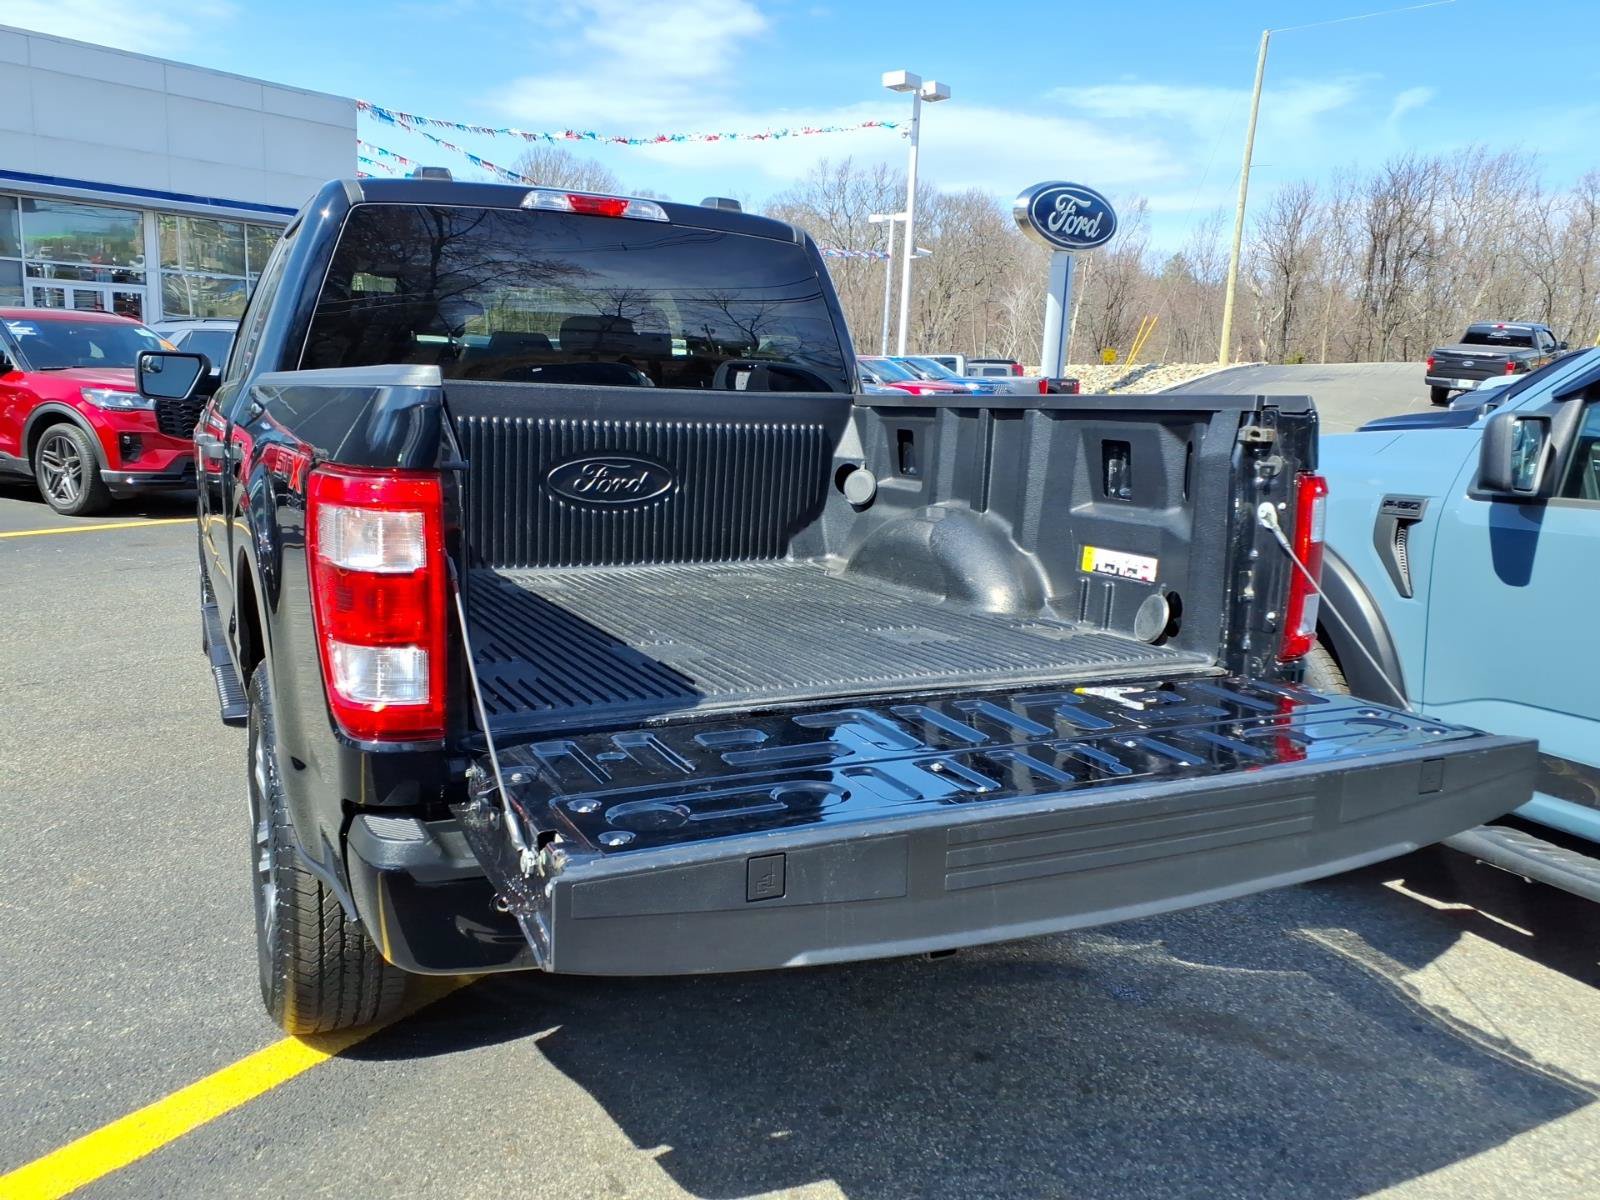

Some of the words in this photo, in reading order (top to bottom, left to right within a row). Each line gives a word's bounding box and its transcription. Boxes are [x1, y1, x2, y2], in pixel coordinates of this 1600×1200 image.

[1048, 194, 1103, 238] Ford
[274, 452, 305, 494] STX
[573, 462, 649, 493] Ford
